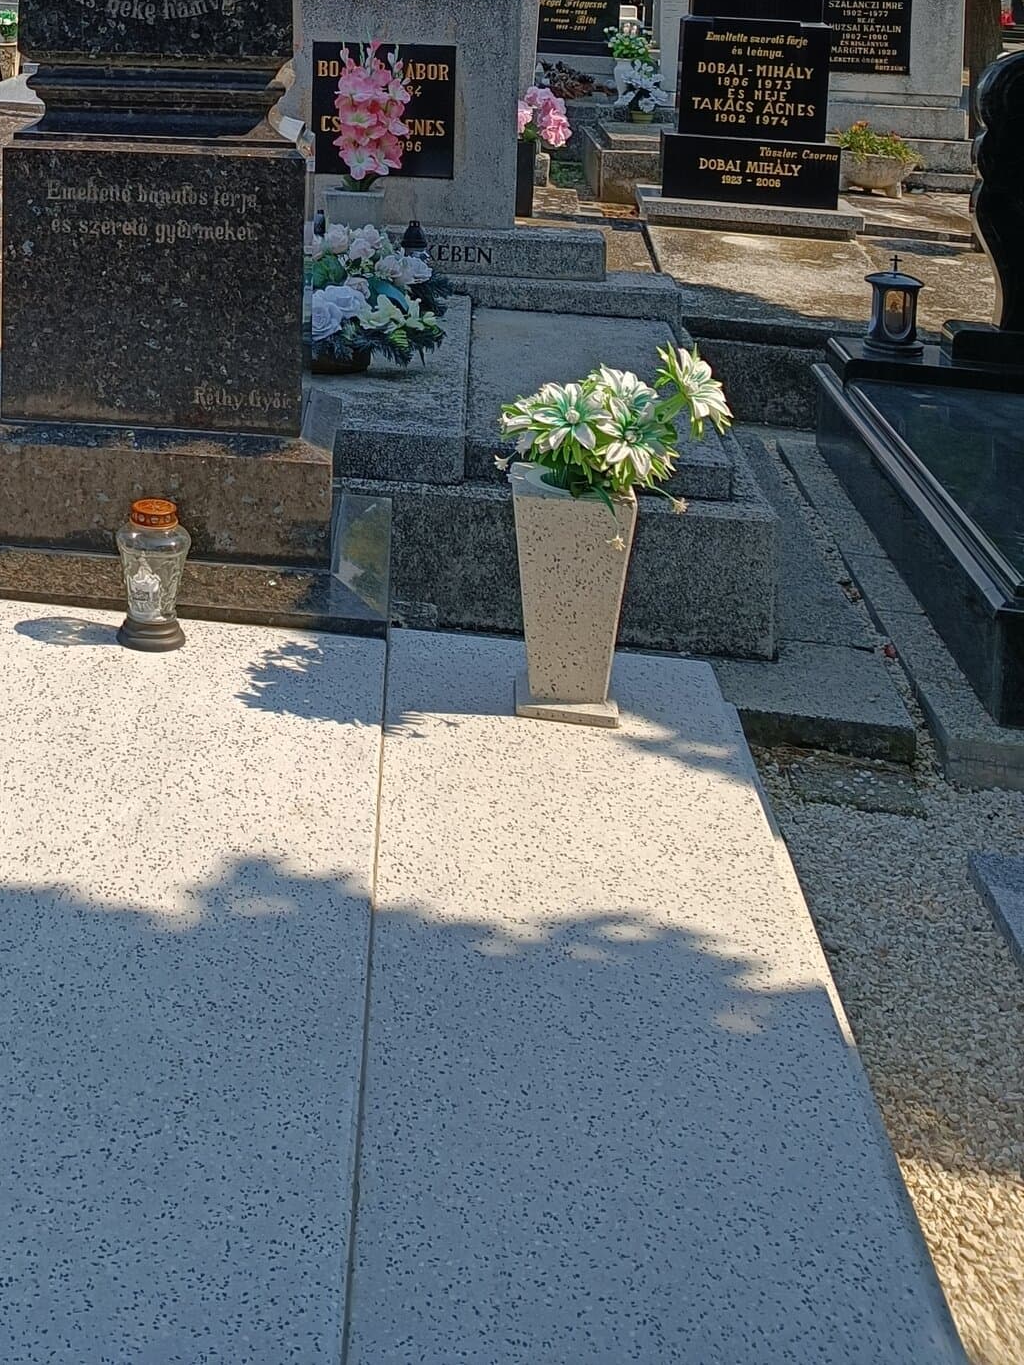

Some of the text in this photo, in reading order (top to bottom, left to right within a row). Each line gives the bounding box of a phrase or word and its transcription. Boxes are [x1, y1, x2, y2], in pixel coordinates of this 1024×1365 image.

[883, 2, 904, 10] IMRE
[863, 24, 902, 33] KATALIN
[406, 59, 449, 81] ÁBOR
[698, 61, 743, 76] DOBAI
[756, 63, 814, 80] MIHÁLY
[758, 79, 793, 90] 1973
[727, 85, 788, 102] ÉS NEJE
[692, 96, 754, 113] TAKÁCS
[715, 113, 788, 126] 1902 1974
[801, 149, 838, 161] Csorna
[699, 158, 802, 176] DOBAI MIHÁLY
